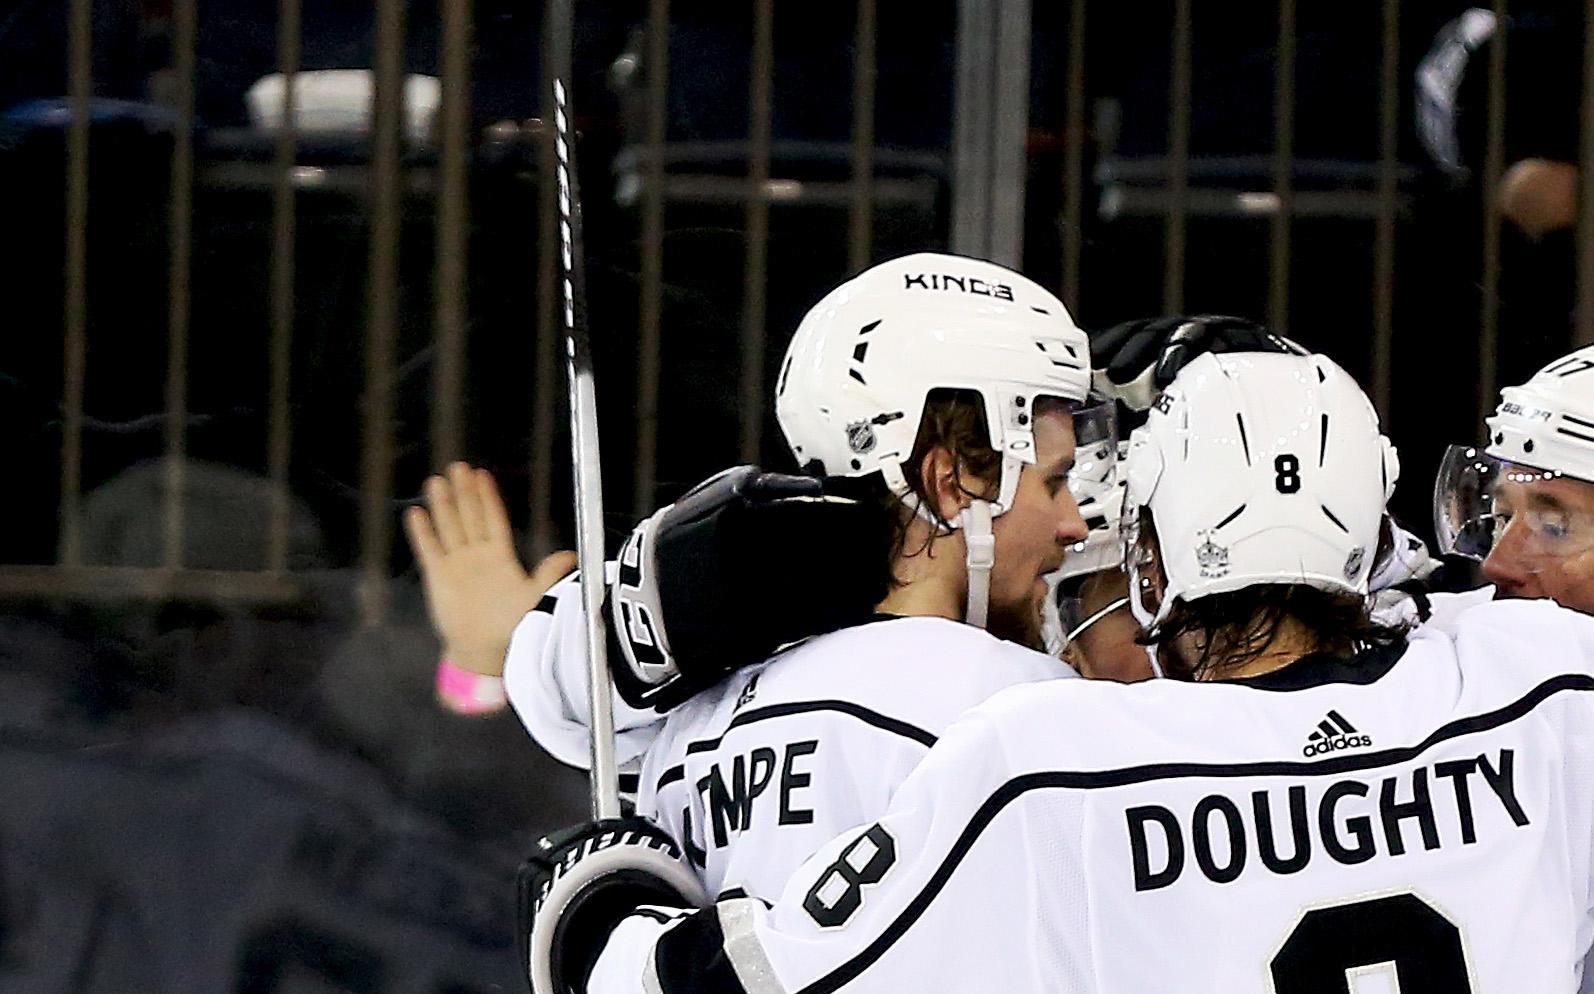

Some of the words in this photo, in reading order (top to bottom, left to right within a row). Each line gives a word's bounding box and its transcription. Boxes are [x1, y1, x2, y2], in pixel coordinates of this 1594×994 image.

[1275, 454, 1300, 494] 8
[1302, 731, 1372, 758] adidas
[1125, 749, 1531, 892] DOUGHTY
[802, 822, 898, 931] 8
